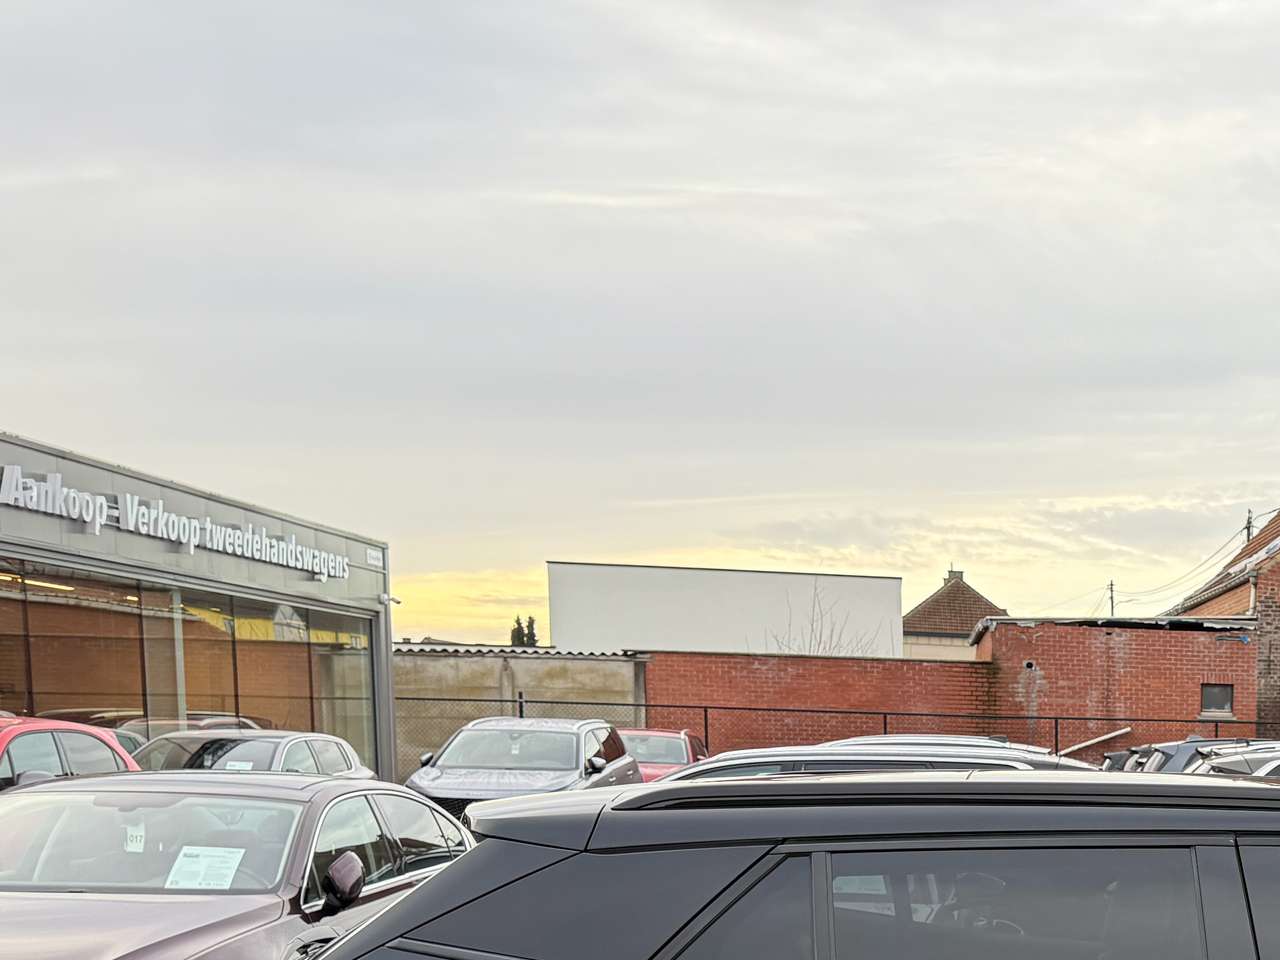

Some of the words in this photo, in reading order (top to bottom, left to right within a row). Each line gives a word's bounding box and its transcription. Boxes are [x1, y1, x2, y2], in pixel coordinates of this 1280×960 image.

[1, 465, 108, 535] Aankoop
[120, 493, 199, 555] Verkoop
[205, 517, 349, 583] tweedehandswagens
[129, 834, 143, 844] 017
